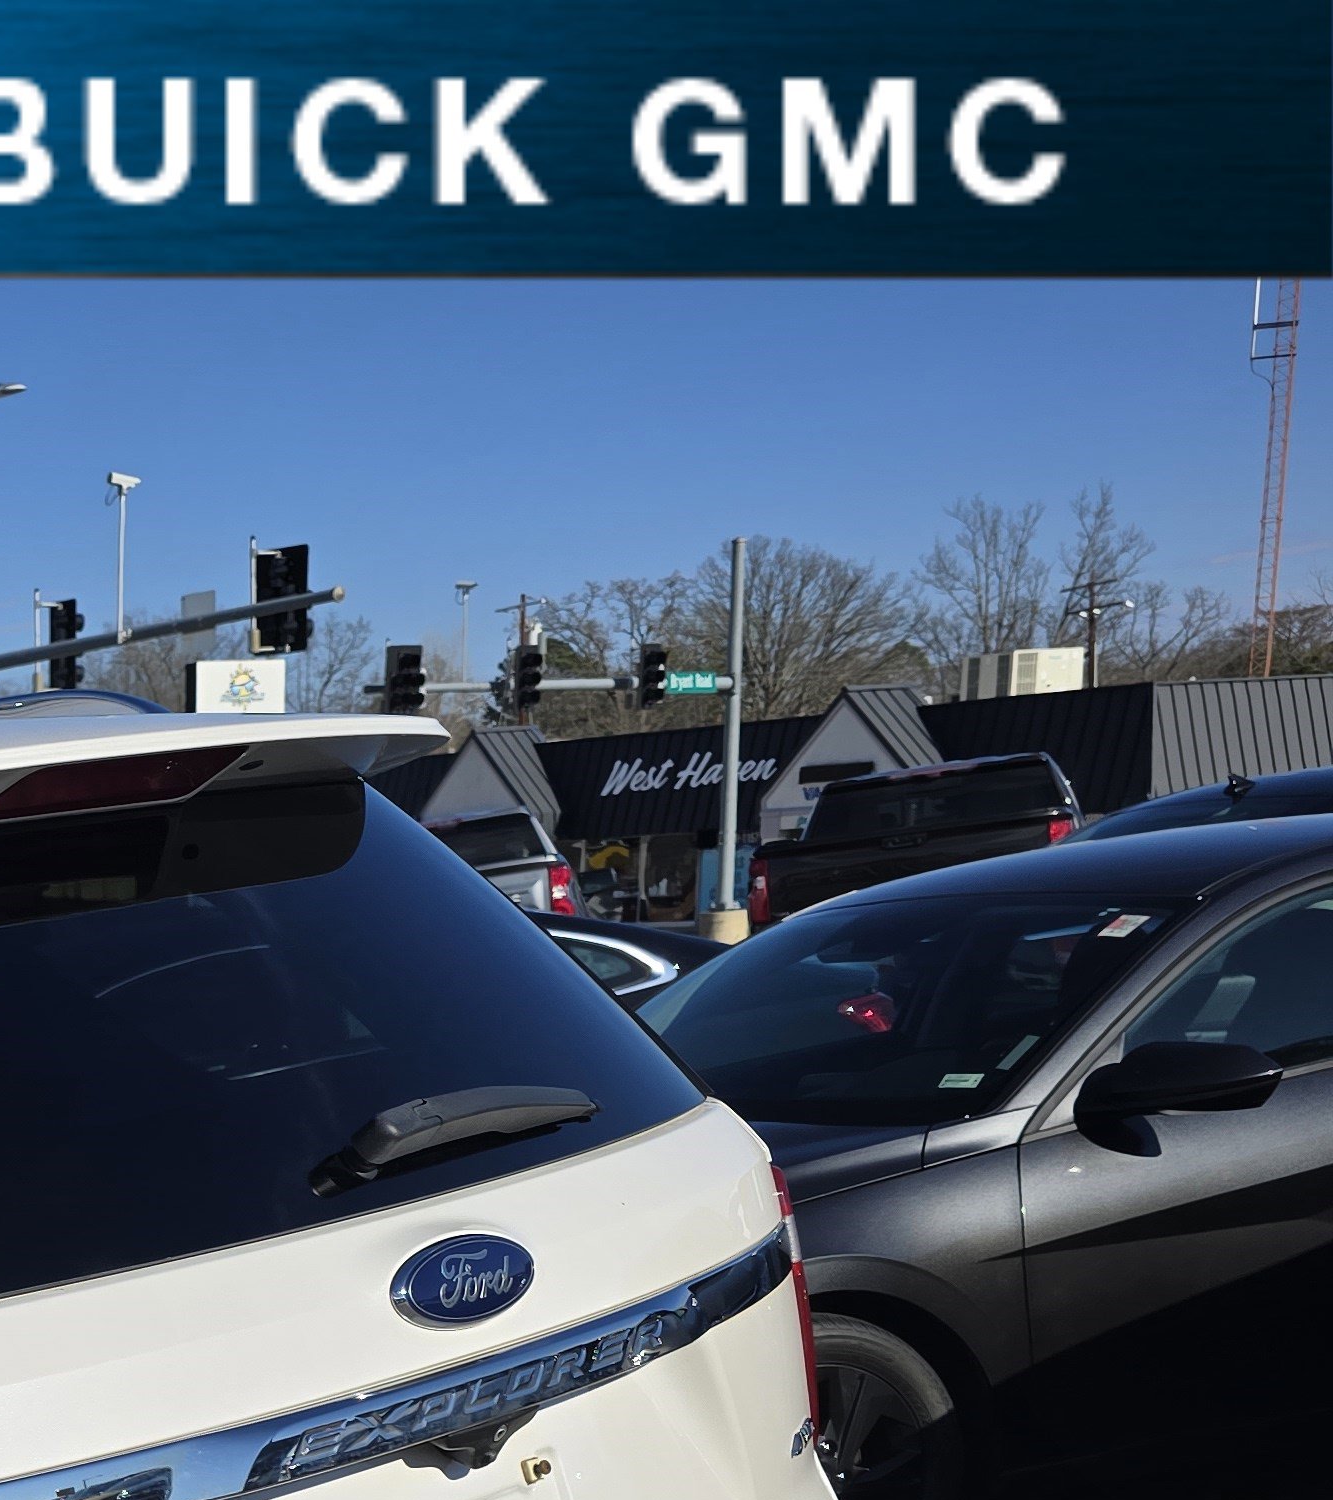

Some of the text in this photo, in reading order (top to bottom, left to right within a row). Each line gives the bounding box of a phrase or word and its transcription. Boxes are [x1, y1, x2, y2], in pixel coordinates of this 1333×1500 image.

[600, 751, 778, 797] West Haen
[440, 1248, 514, 1308] Ford
[289, 1314, 665, 1466] EXPLORER
